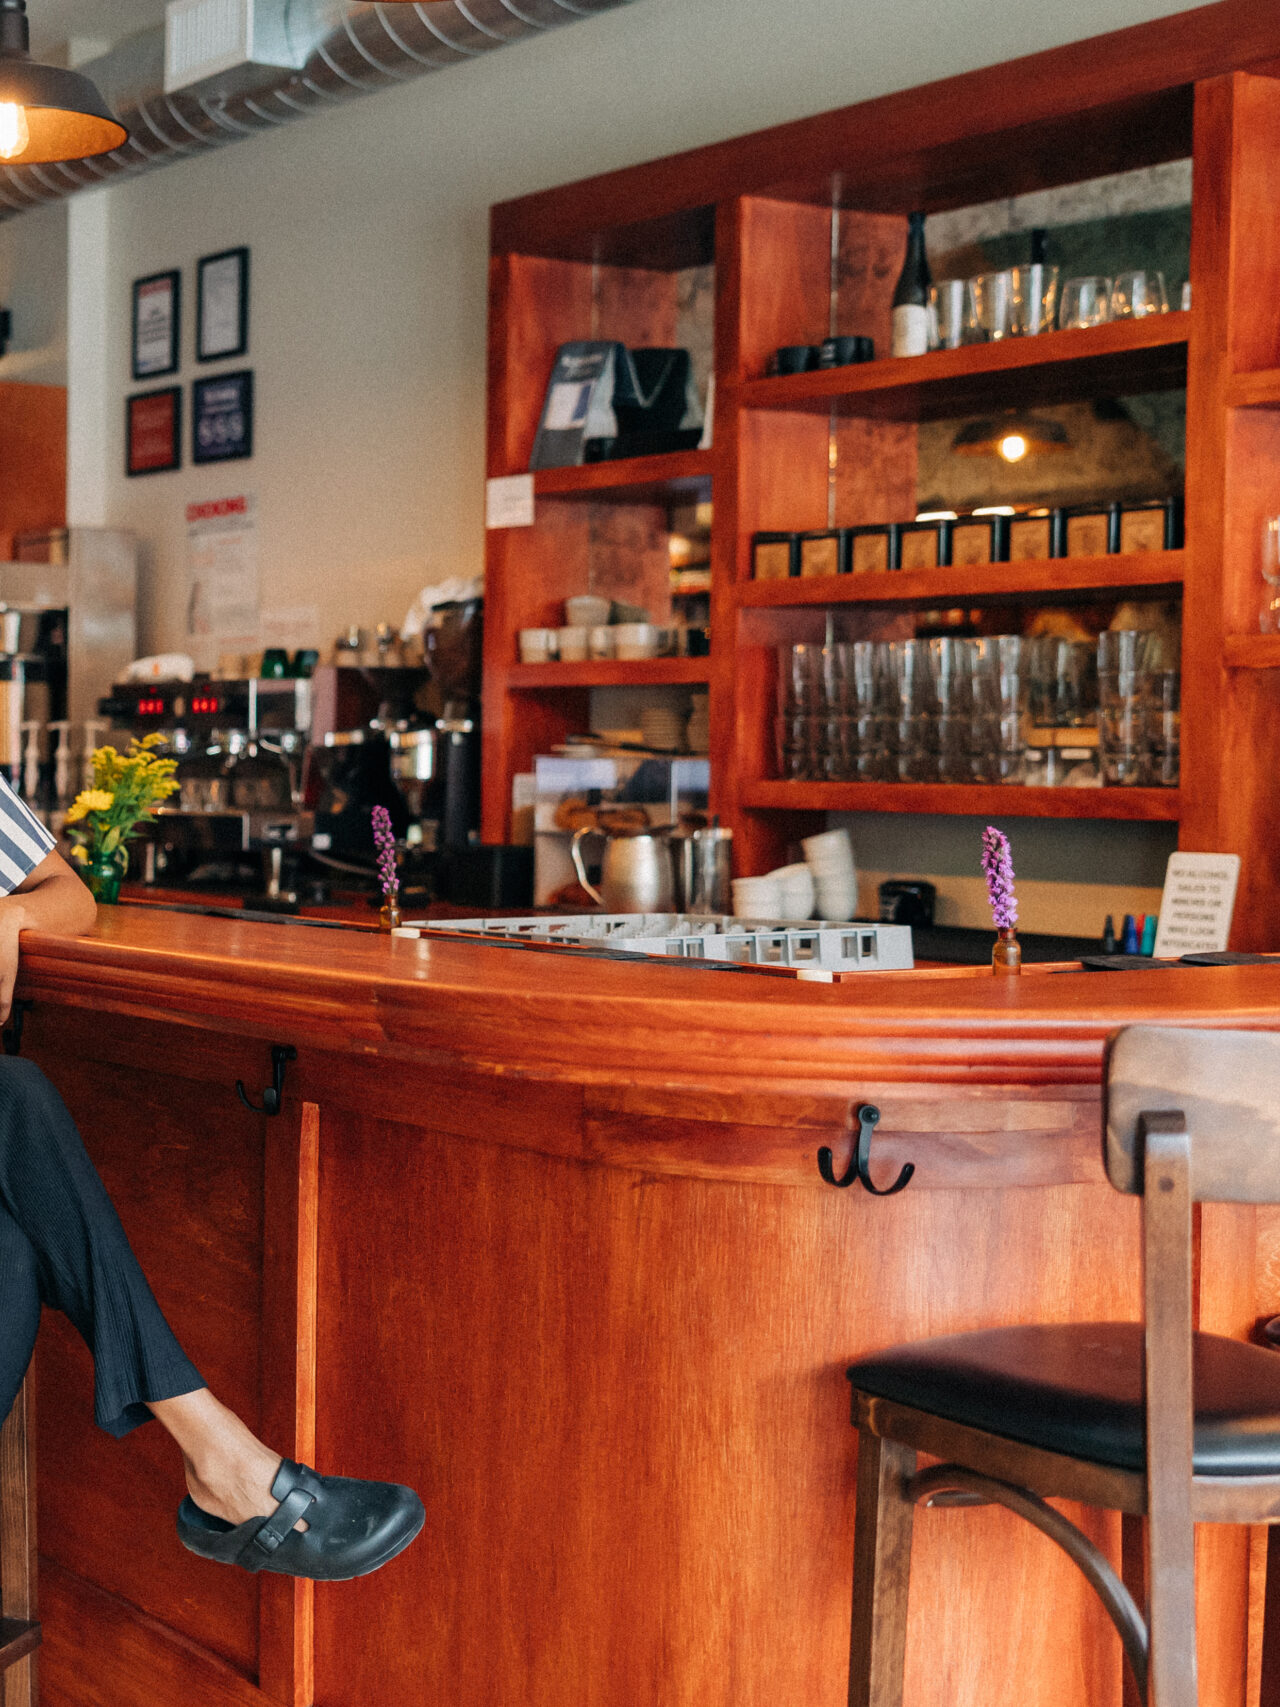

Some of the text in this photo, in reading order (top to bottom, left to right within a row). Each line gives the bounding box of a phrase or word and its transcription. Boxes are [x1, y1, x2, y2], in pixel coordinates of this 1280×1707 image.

[1171, 869, 1228, 880] NO ALCOHOL
[1178, 883, 1220, 893] SALES TO
[1172, 897, 1222, 908] MINORS OR
[1173, 912, 1215, 921] PERSONS
[1168, 926, 1215, 935] WHO LOOK
[1161, 939, 1218, 950] INTOXICATED
